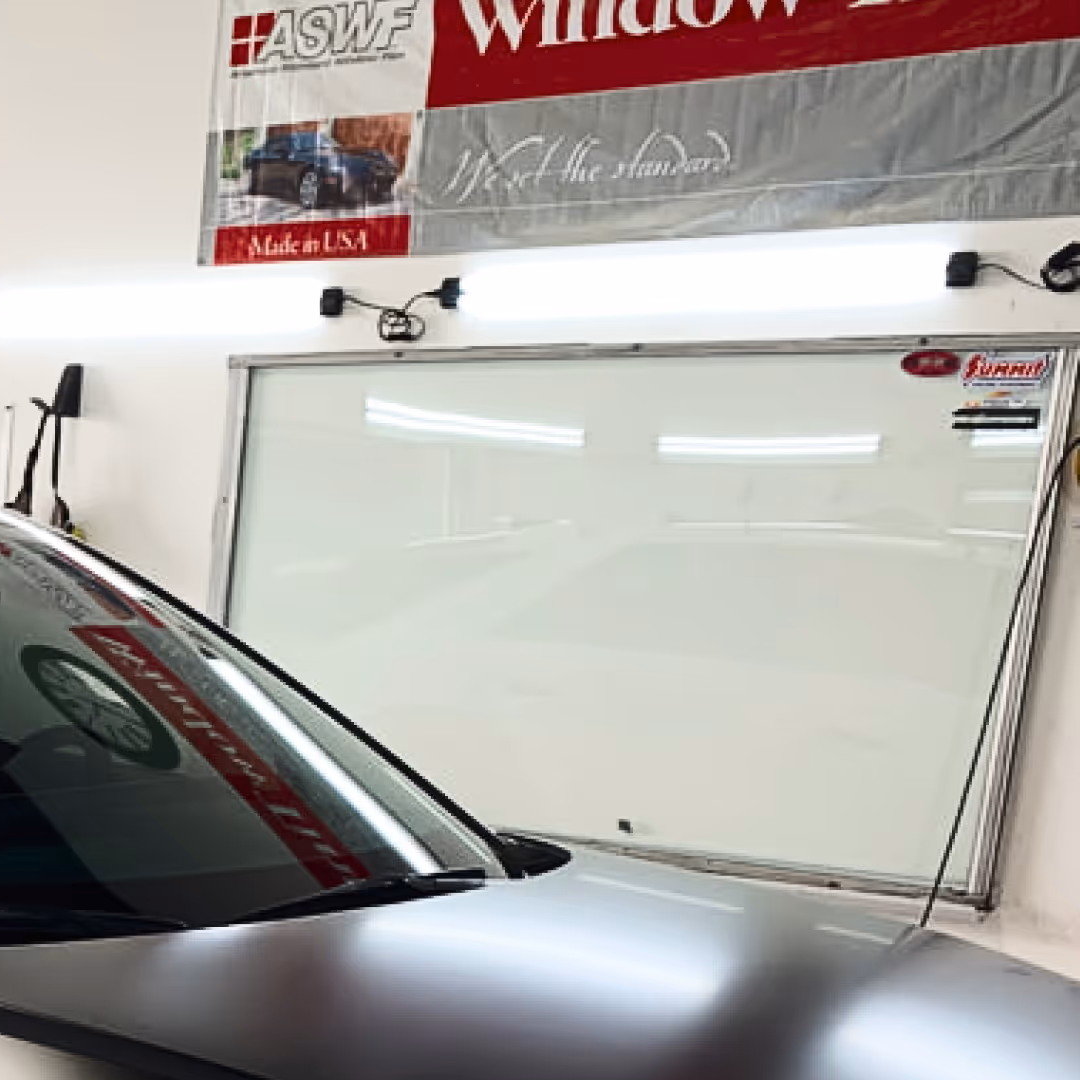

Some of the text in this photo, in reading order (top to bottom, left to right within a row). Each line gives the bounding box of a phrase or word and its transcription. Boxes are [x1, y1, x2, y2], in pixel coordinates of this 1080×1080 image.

[254, 0, 418, 64] ASWF
[248, 231, 300, 257] Made
[322, 228, 367, 253] USA
